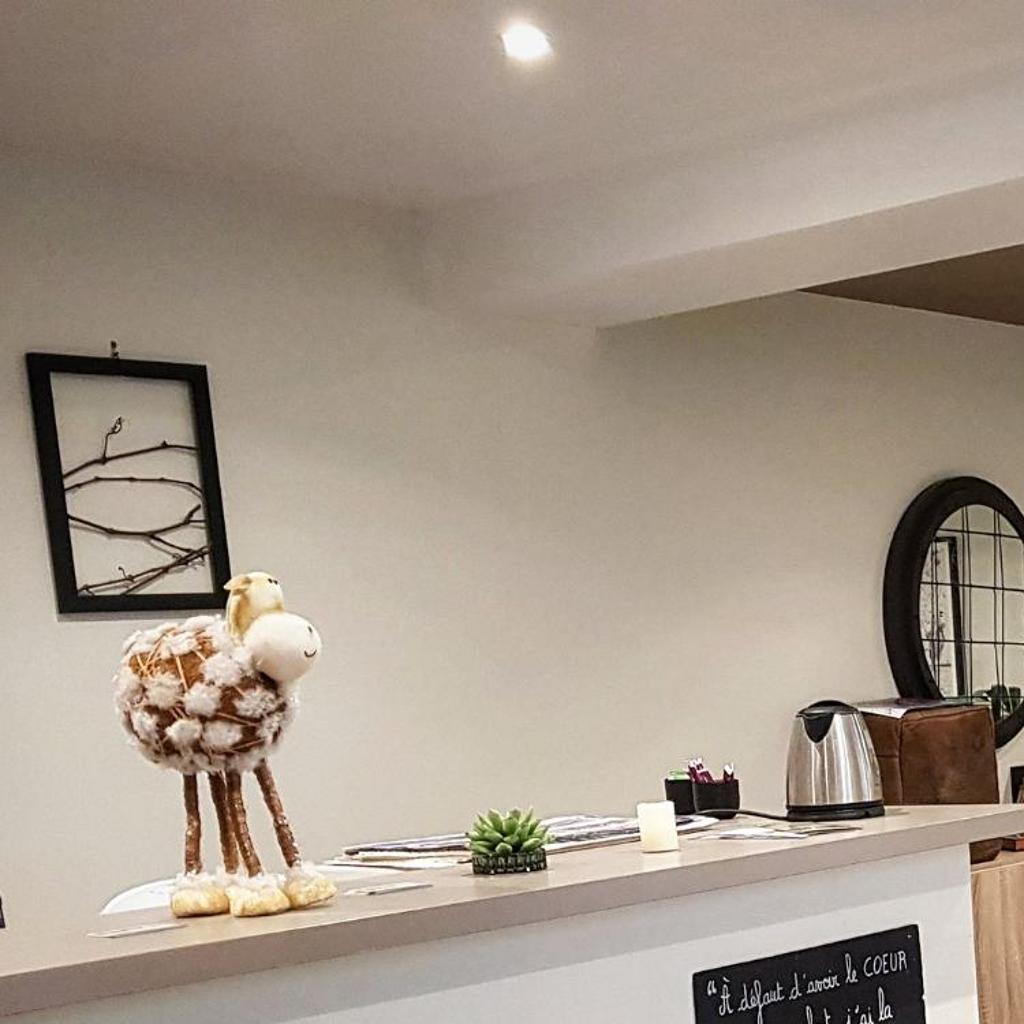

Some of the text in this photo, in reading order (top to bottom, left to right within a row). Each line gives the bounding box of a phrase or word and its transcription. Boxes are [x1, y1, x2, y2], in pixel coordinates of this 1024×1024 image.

[789, 971, 841, 1000] d'avoir
[845, 953, 858, 984] le
[863, 950, 908, 977] COEUR
[877, 987, 894, 1021] la
